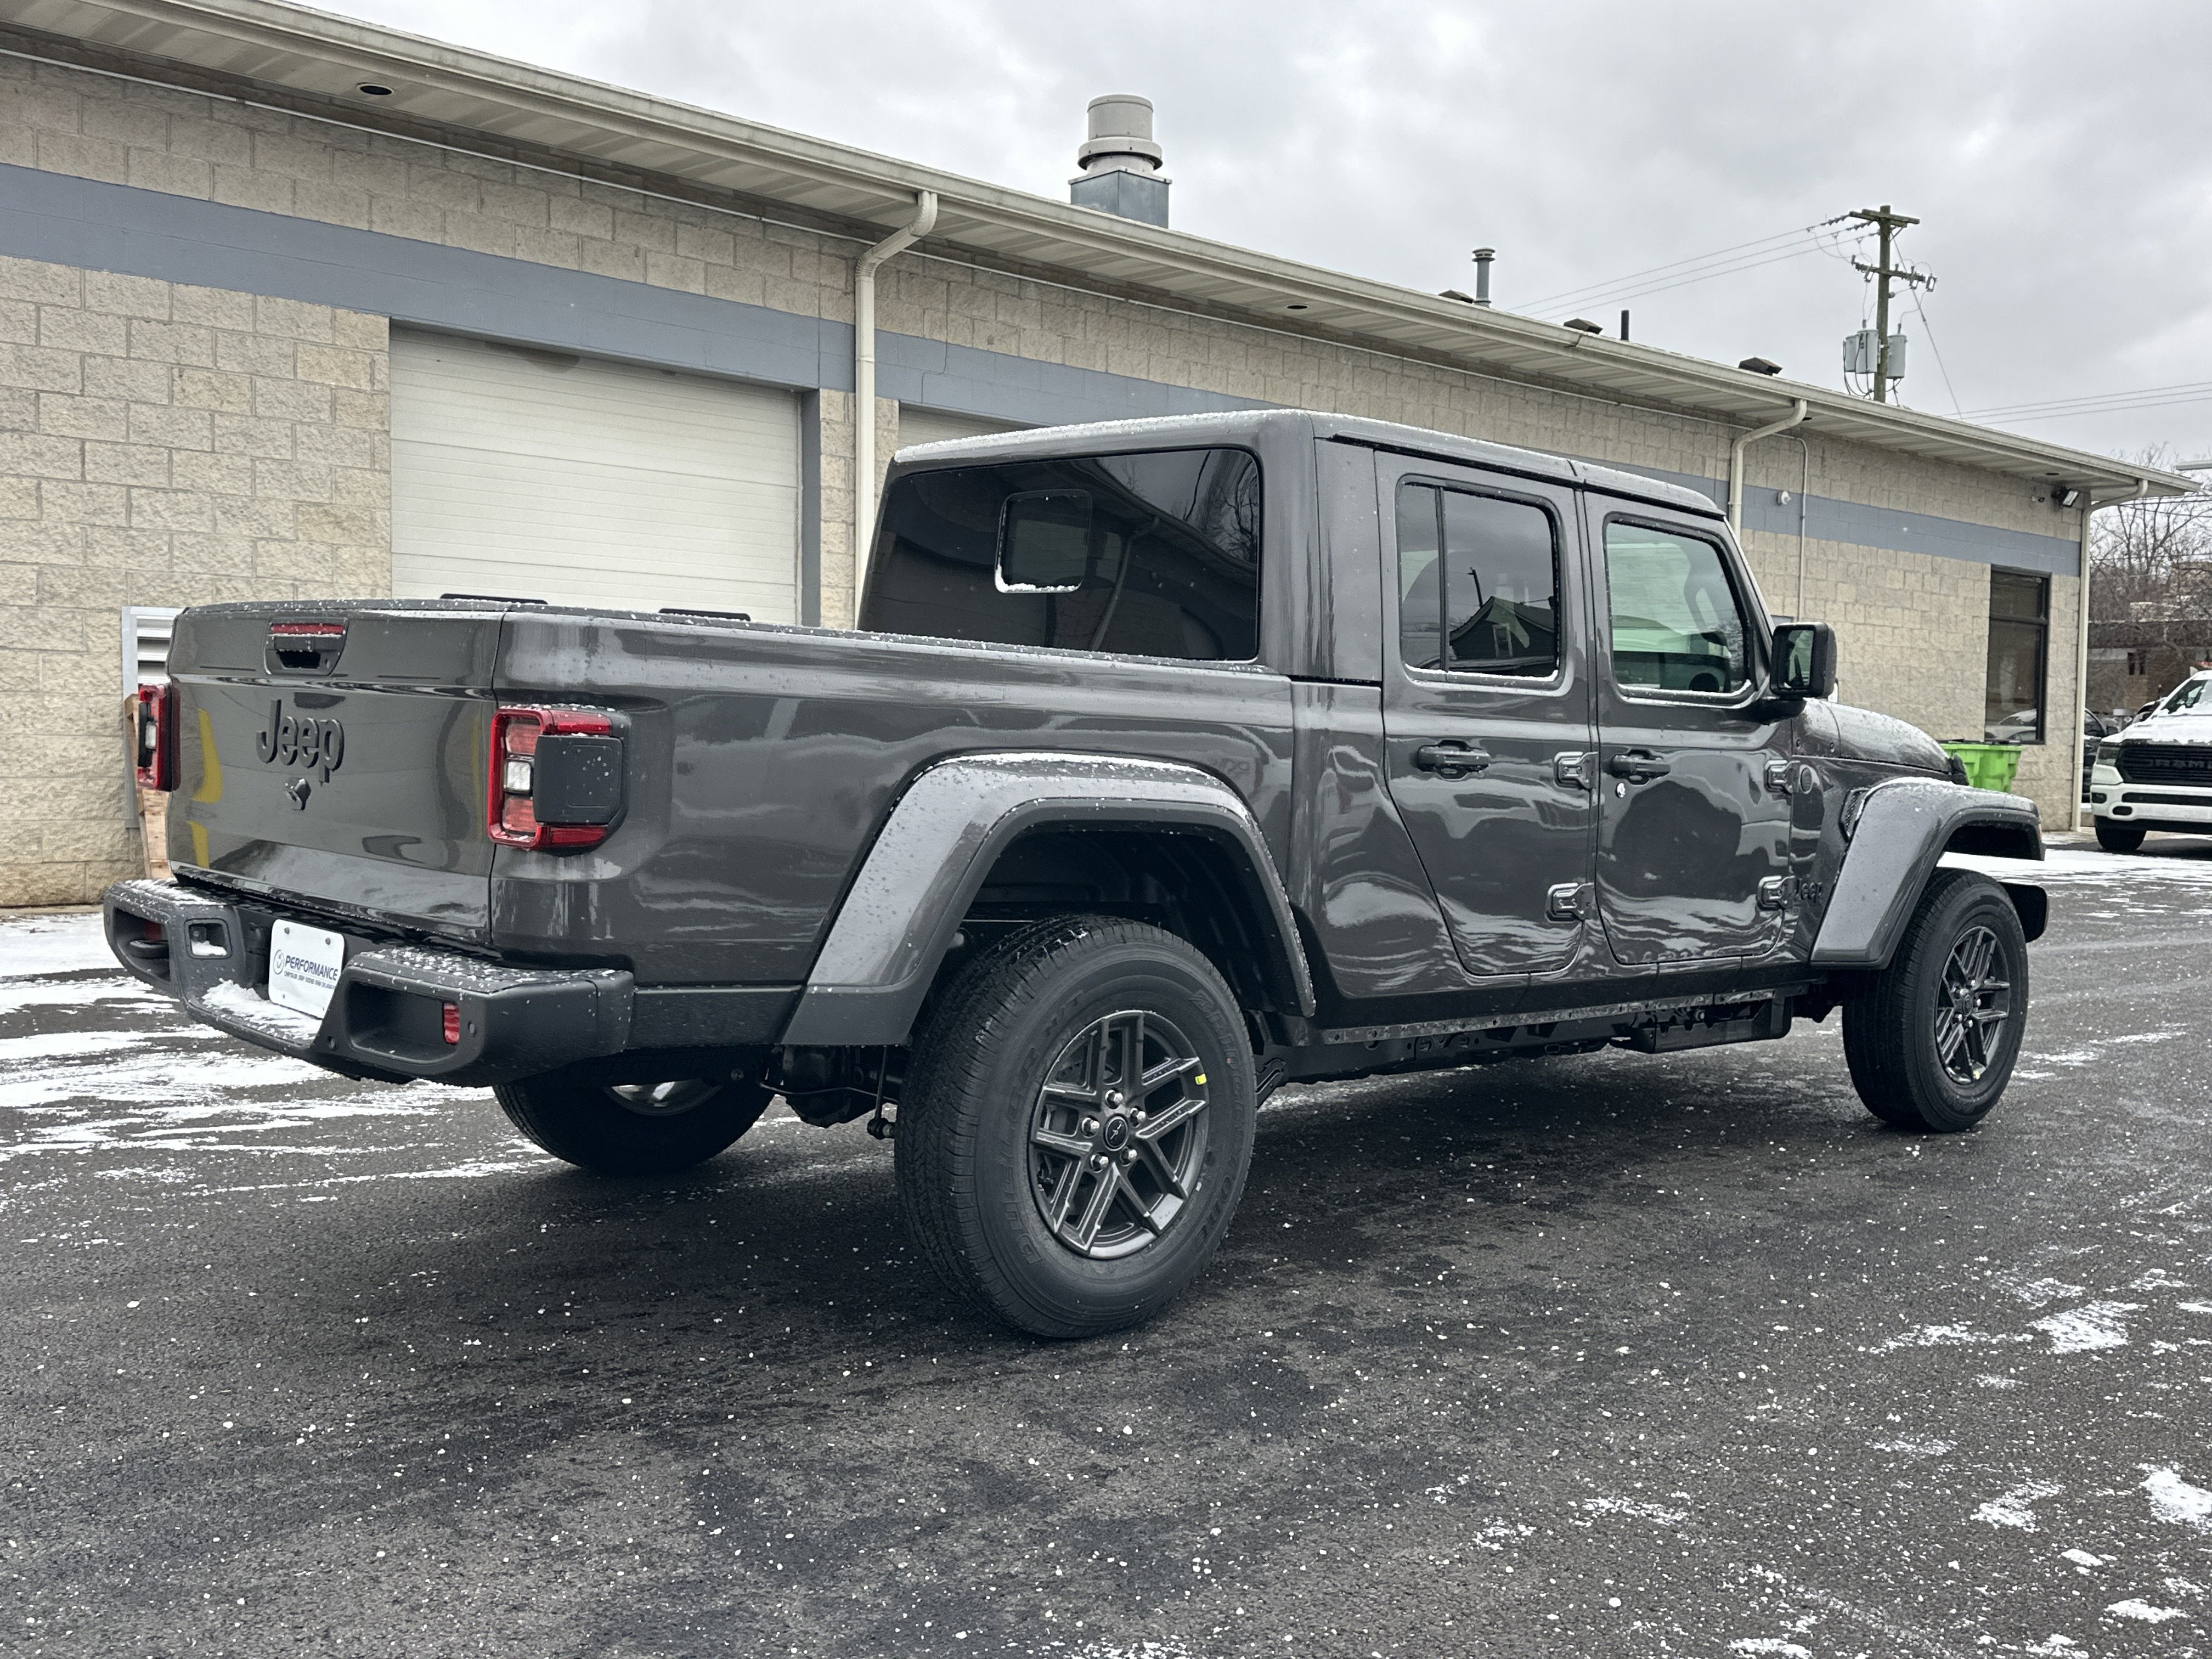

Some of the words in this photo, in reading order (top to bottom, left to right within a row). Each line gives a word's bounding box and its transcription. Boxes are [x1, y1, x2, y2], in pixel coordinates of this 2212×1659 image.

[256, 699, 345, 784] Jeep
[2155, 759, 2205, 769] RAM
[1793, 877, 1822, 903] Jeep
[285, 955, 338, 980] PERFORMANCE
[1188, 989, 1244, 1247] BRIDGETONE
